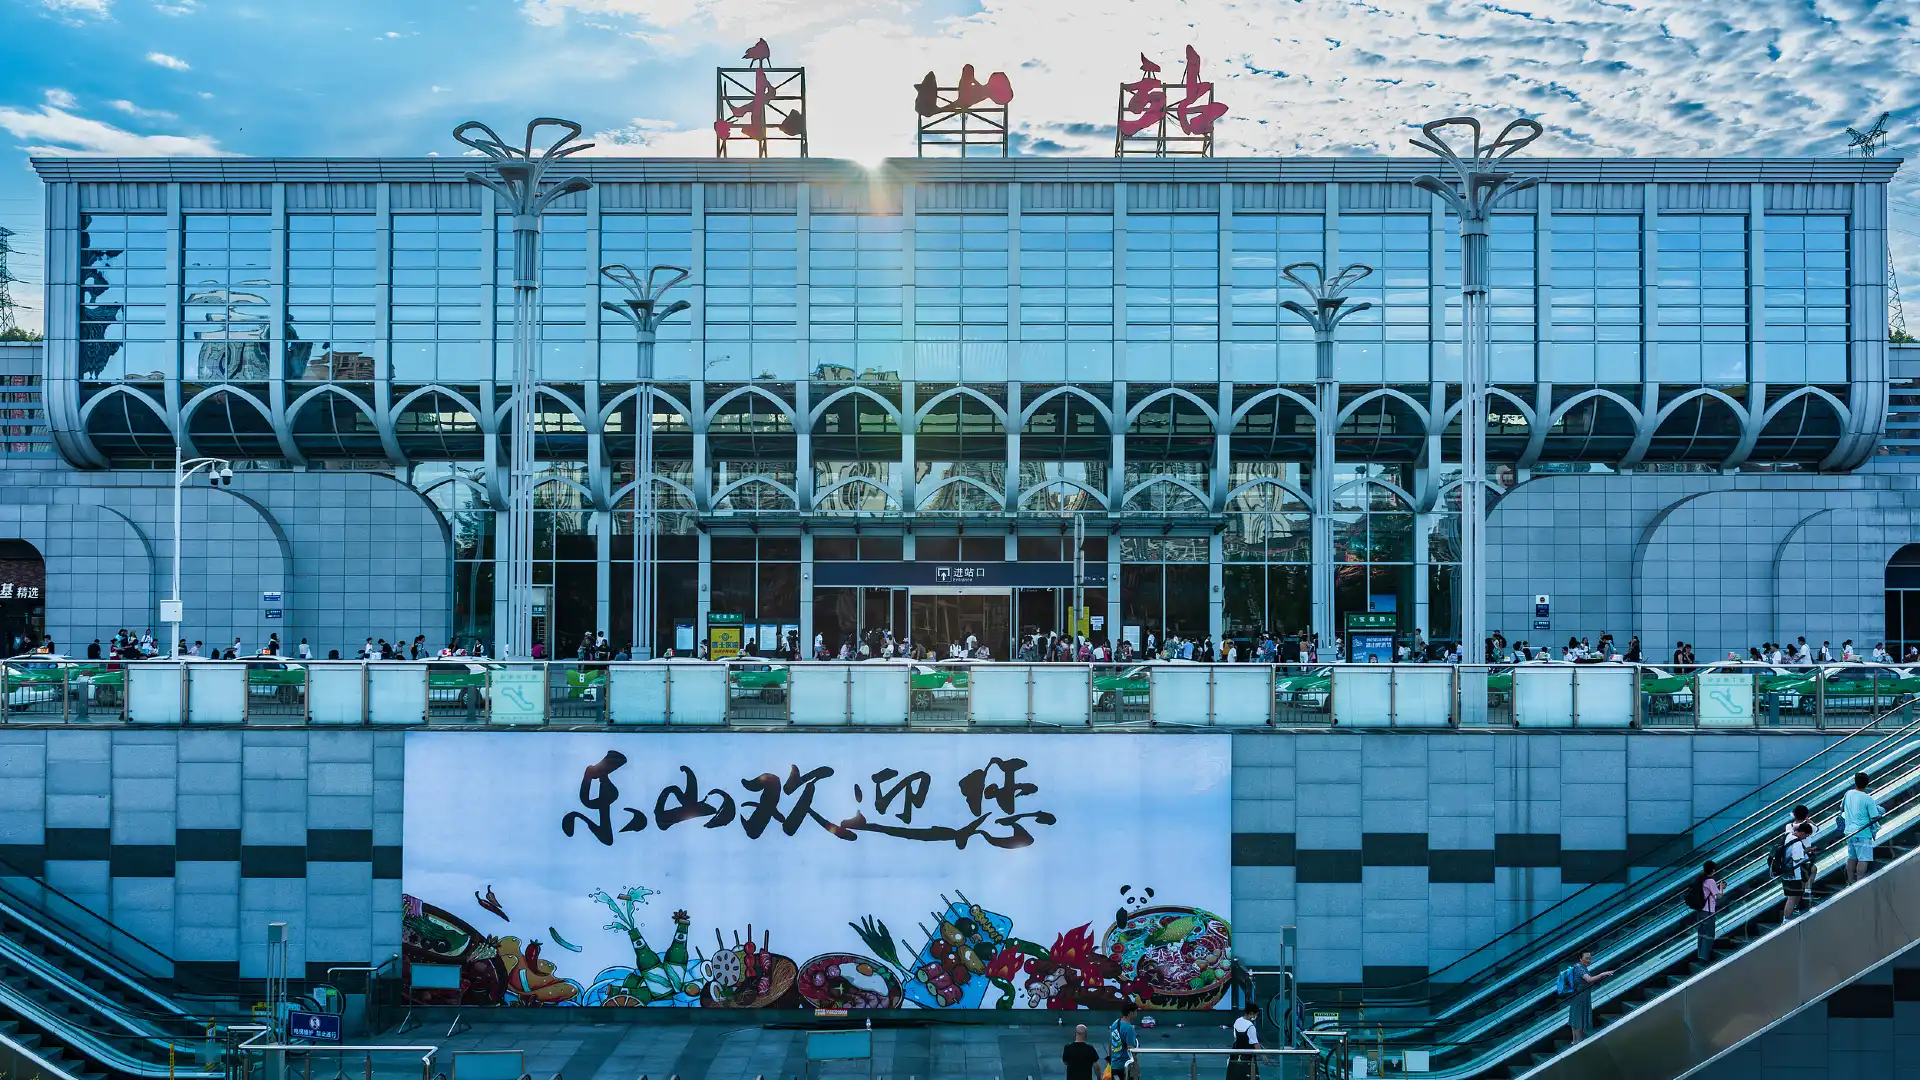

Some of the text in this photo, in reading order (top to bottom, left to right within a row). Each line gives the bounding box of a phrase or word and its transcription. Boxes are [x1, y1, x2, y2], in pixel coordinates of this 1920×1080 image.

[953, 567, 985, 578] 进站口
[17, 586, 39, 599] 精选
[562, 750, 1057, 850] 乐山欢迎您
